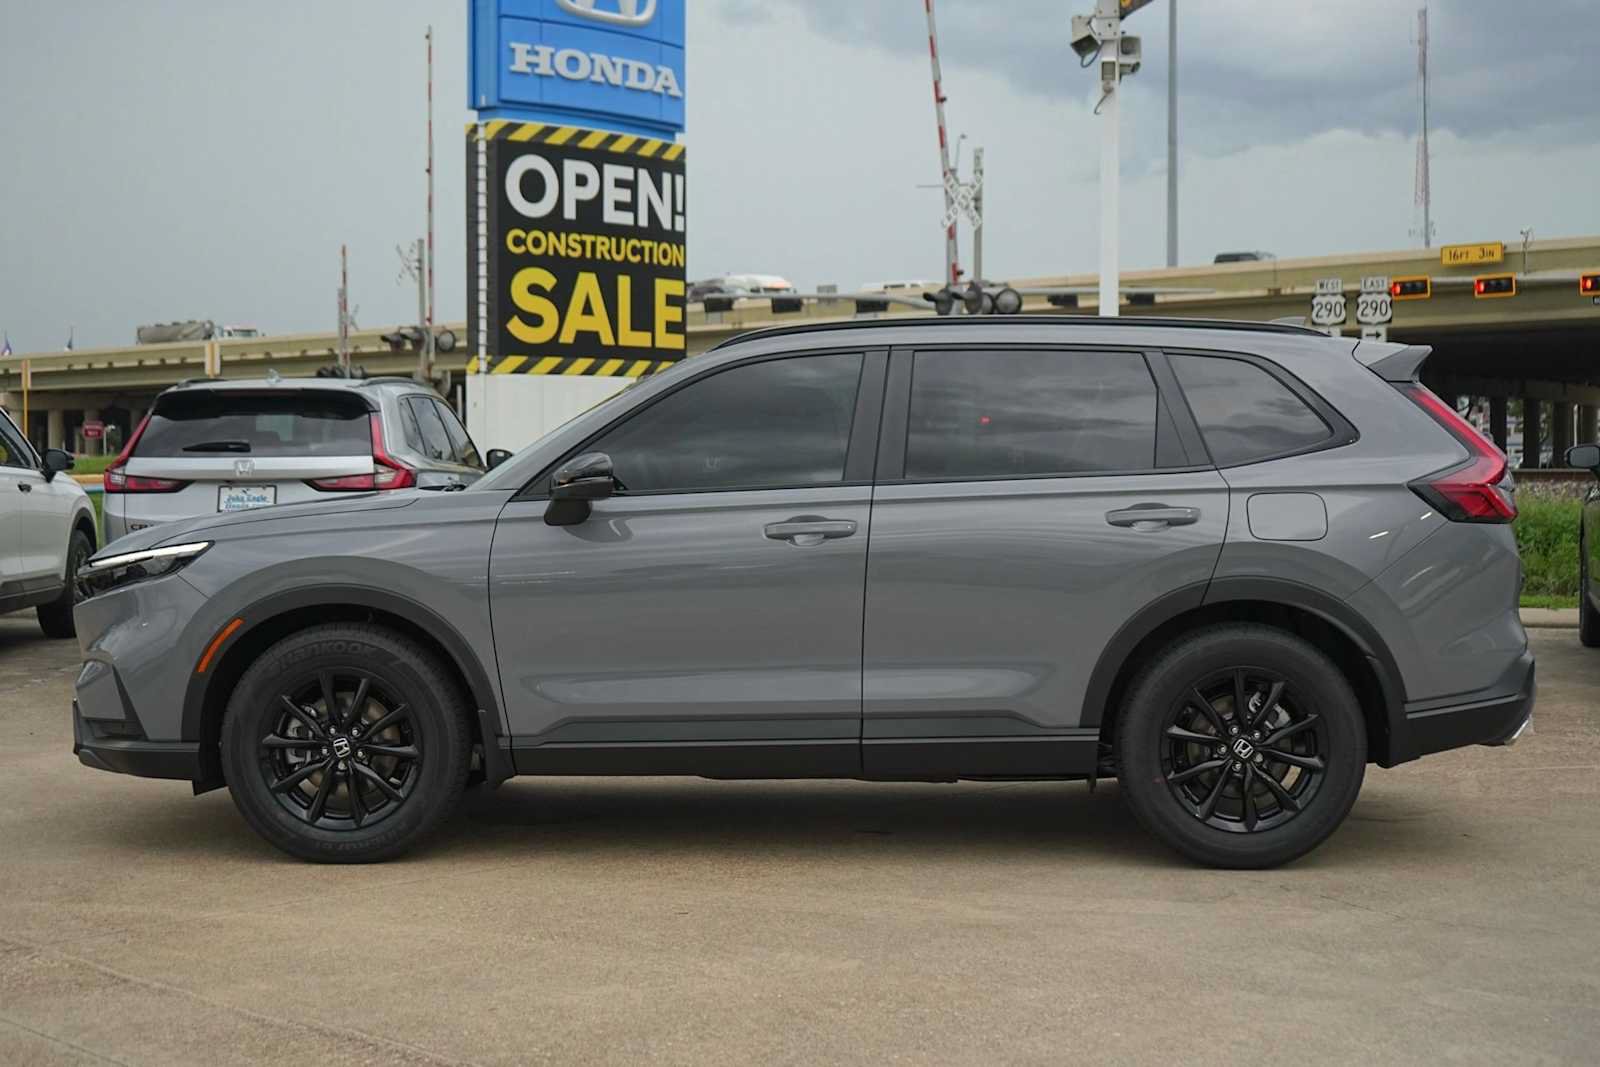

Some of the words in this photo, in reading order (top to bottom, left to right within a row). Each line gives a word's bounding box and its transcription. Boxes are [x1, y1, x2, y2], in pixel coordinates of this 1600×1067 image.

[509, 42, 683, 98] HONDA
[505, 154, 685, 232] OPEN!
[506, 228, 684, 268] CONSTRUCTION
[1363, 278, 1385, 289] EAST
[506, 266, 685, 349] SALE
[1315, 301, 1342, 318] 290
[1360, 300, 1388, 317] 290
